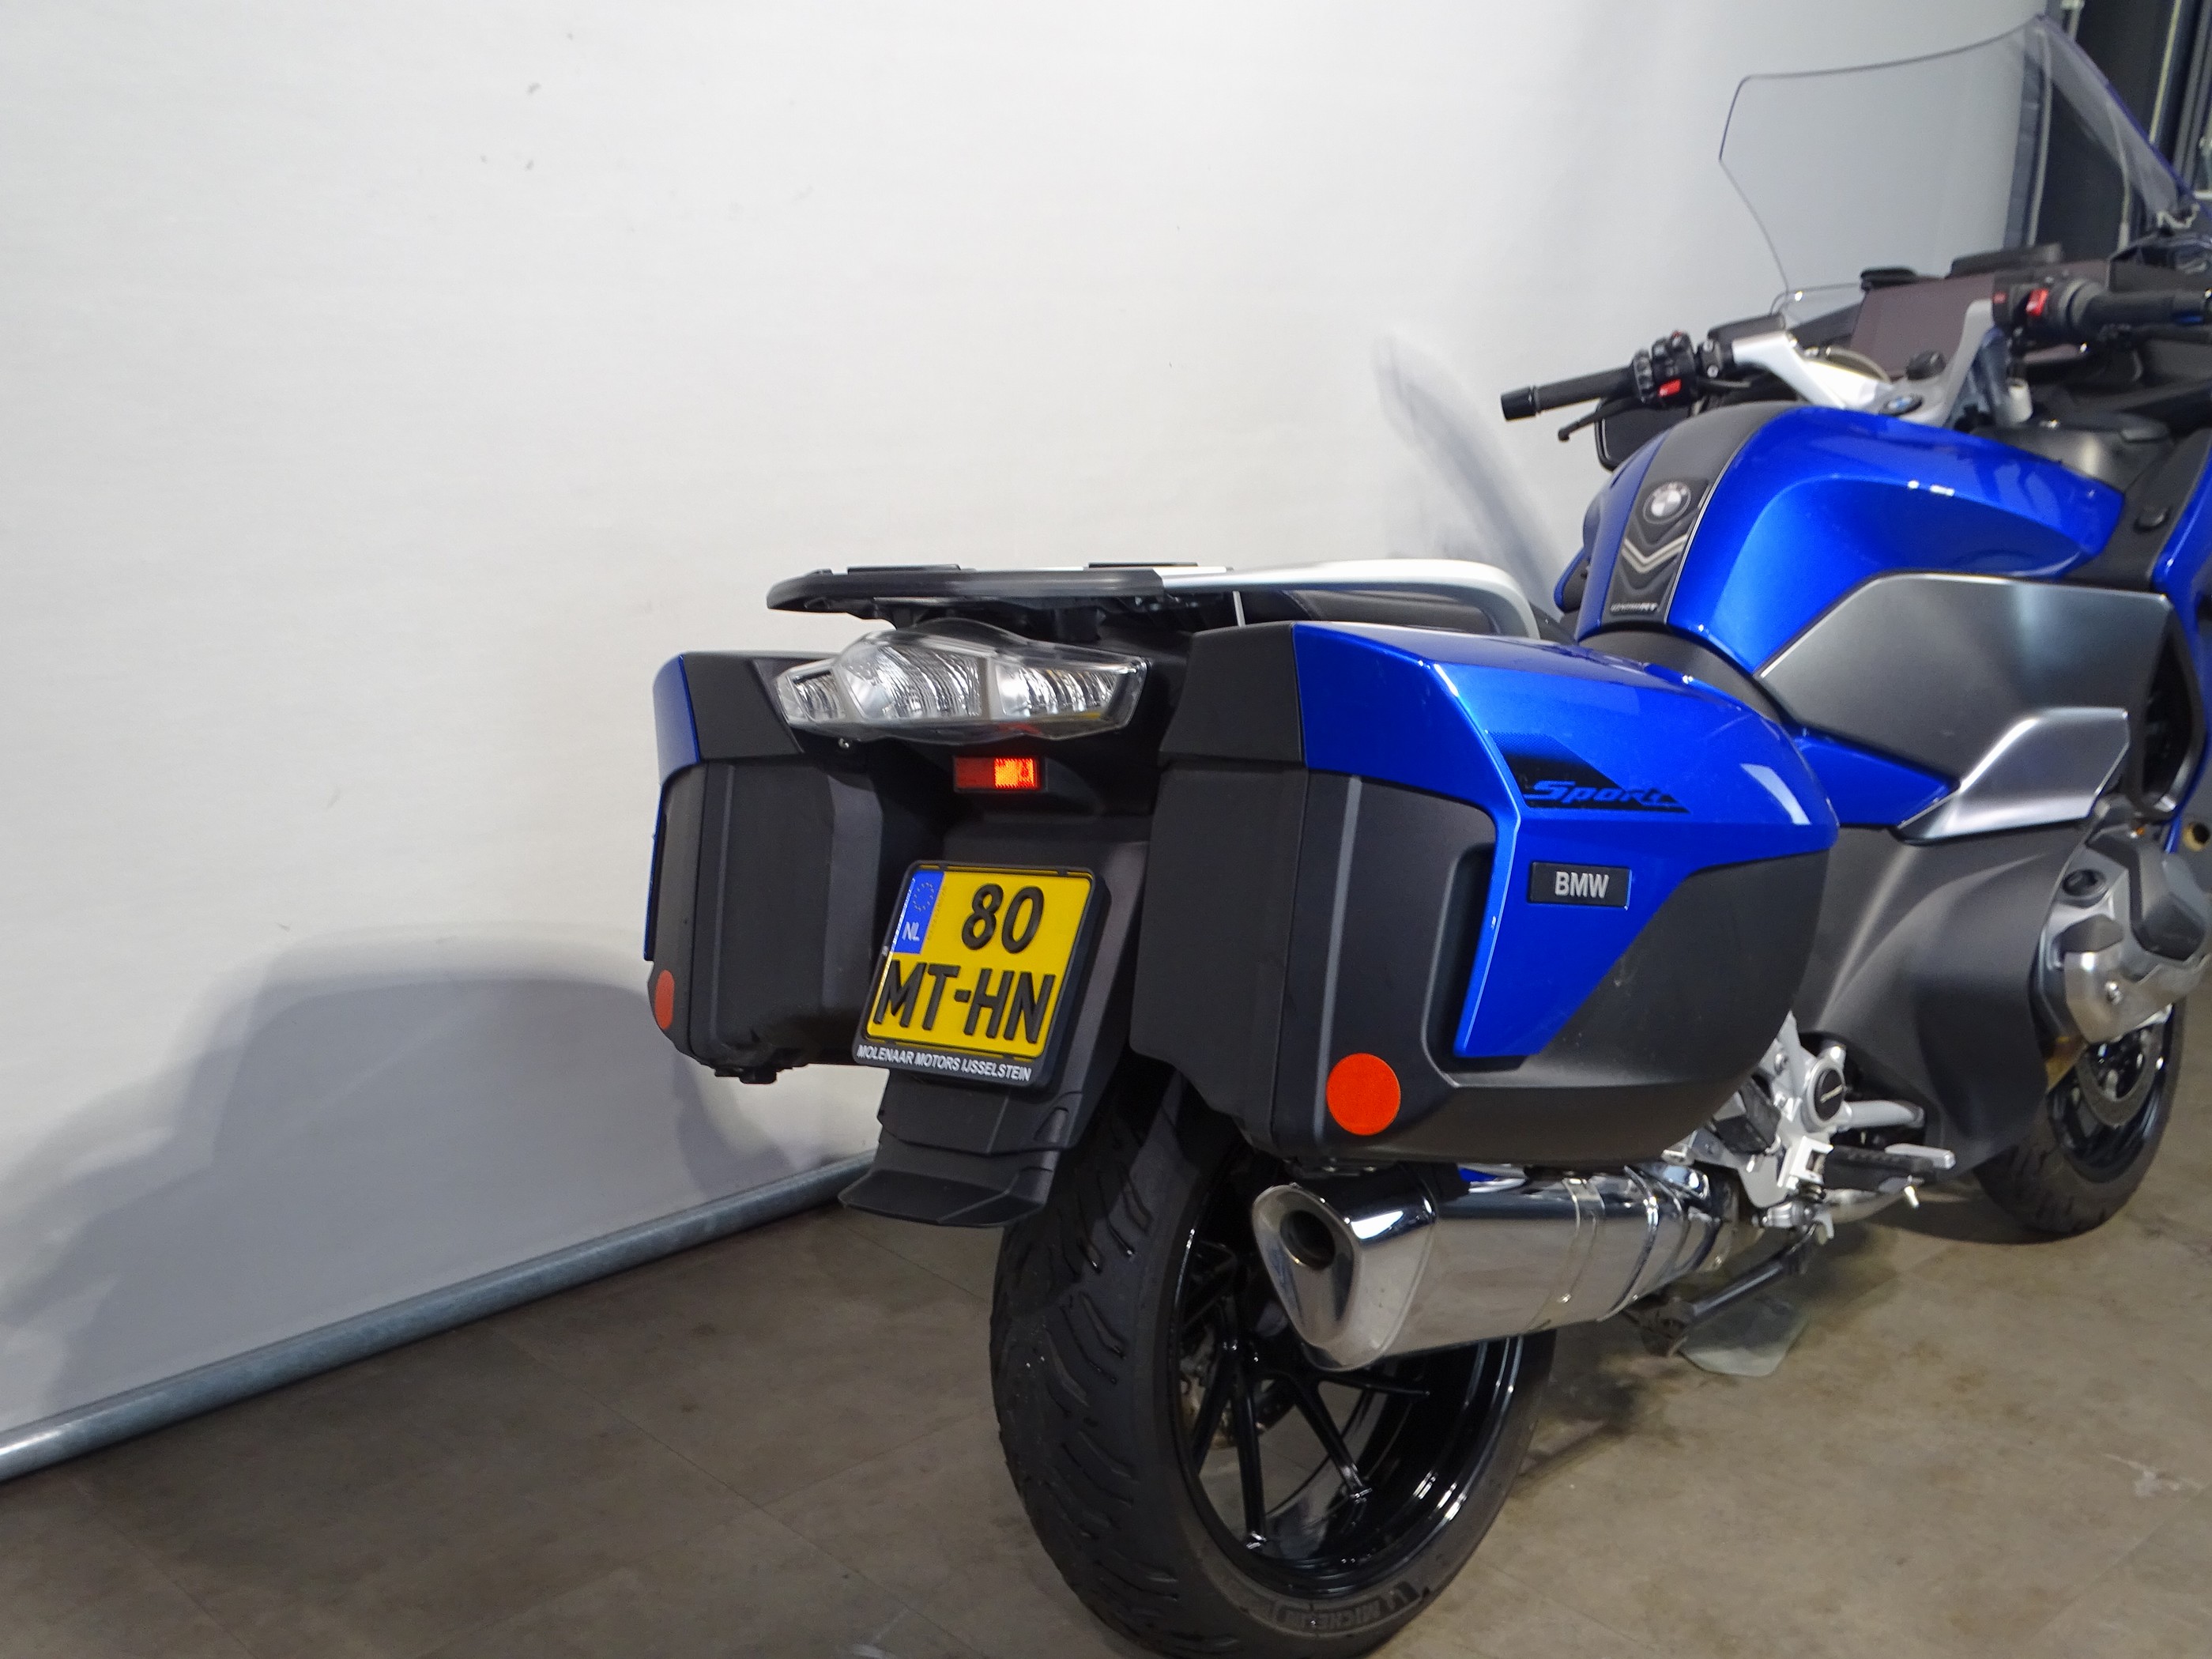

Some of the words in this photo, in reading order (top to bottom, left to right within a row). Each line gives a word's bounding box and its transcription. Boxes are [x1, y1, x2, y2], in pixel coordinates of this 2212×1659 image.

[1524, 780, 1681, 806] Sport
[1554, 871, 1610, 899] BMW
[902, 921, 920, 941] NL
[962, 883, 1045, 954] 80
[873, 959, 1055, 1044] MT-HN
[857, 1045, 914, 1065] MOLENAAR
[914, 1053, 961, 1071] MOTORS
[961, 1059, 1031, 1080] IJSSELSTEIN
